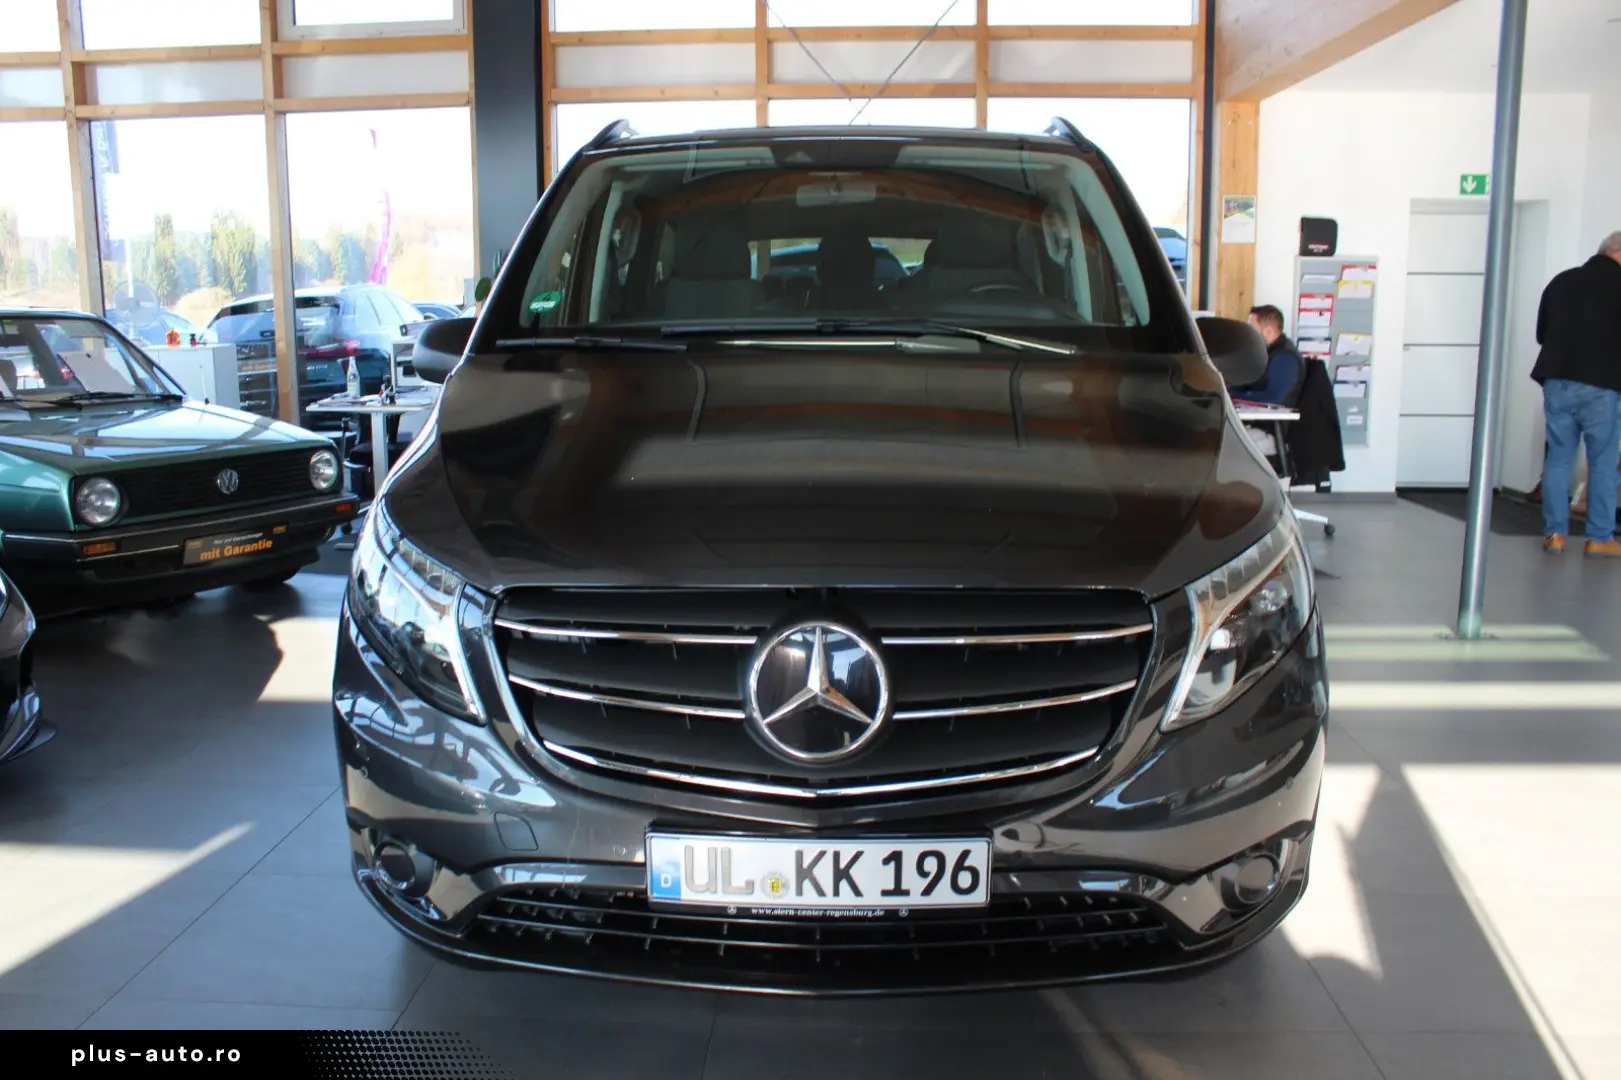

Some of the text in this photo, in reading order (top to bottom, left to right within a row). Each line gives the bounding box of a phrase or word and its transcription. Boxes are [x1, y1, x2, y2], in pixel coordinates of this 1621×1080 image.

[200, 539, 273, 561] mit Garantie
[660, 873, 672, 888] D
[684, 845, 755, 895] UL
[795, 850, 865, 898] KK
[880, 849, 980, 897] 196
[751, 907, 885, 918] www.stern-center-regensburg.de
